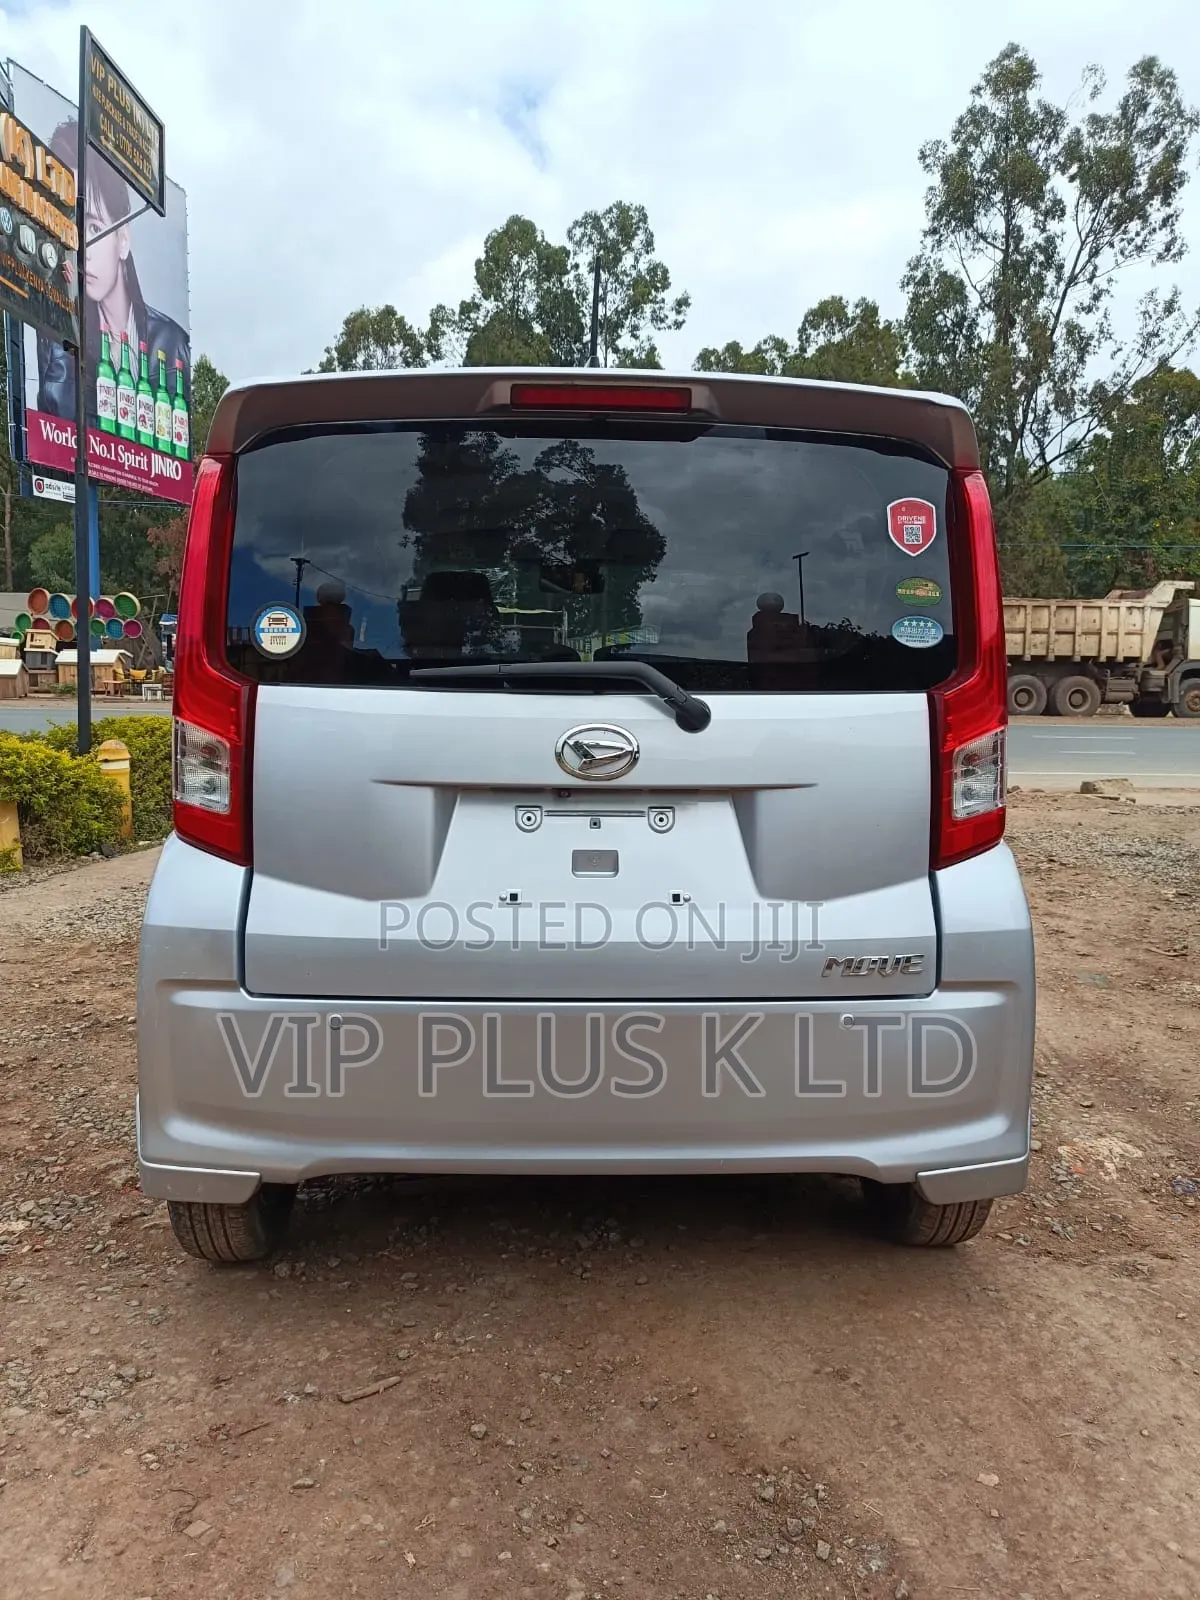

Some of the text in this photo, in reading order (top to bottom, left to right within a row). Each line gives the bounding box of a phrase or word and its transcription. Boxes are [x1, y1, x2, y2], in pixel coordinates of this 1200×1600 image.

[90, 54, 105, 81] VIP
[107, 75, 131, 114] PLUS
[100, 113, 115, 141] CALL
[89, 434, 116, 460] No.1
[117, 444, 148, 471] Spirit
[150, 452, 182, 481] JINRO
[821, 953, 925, 977] MOVE
